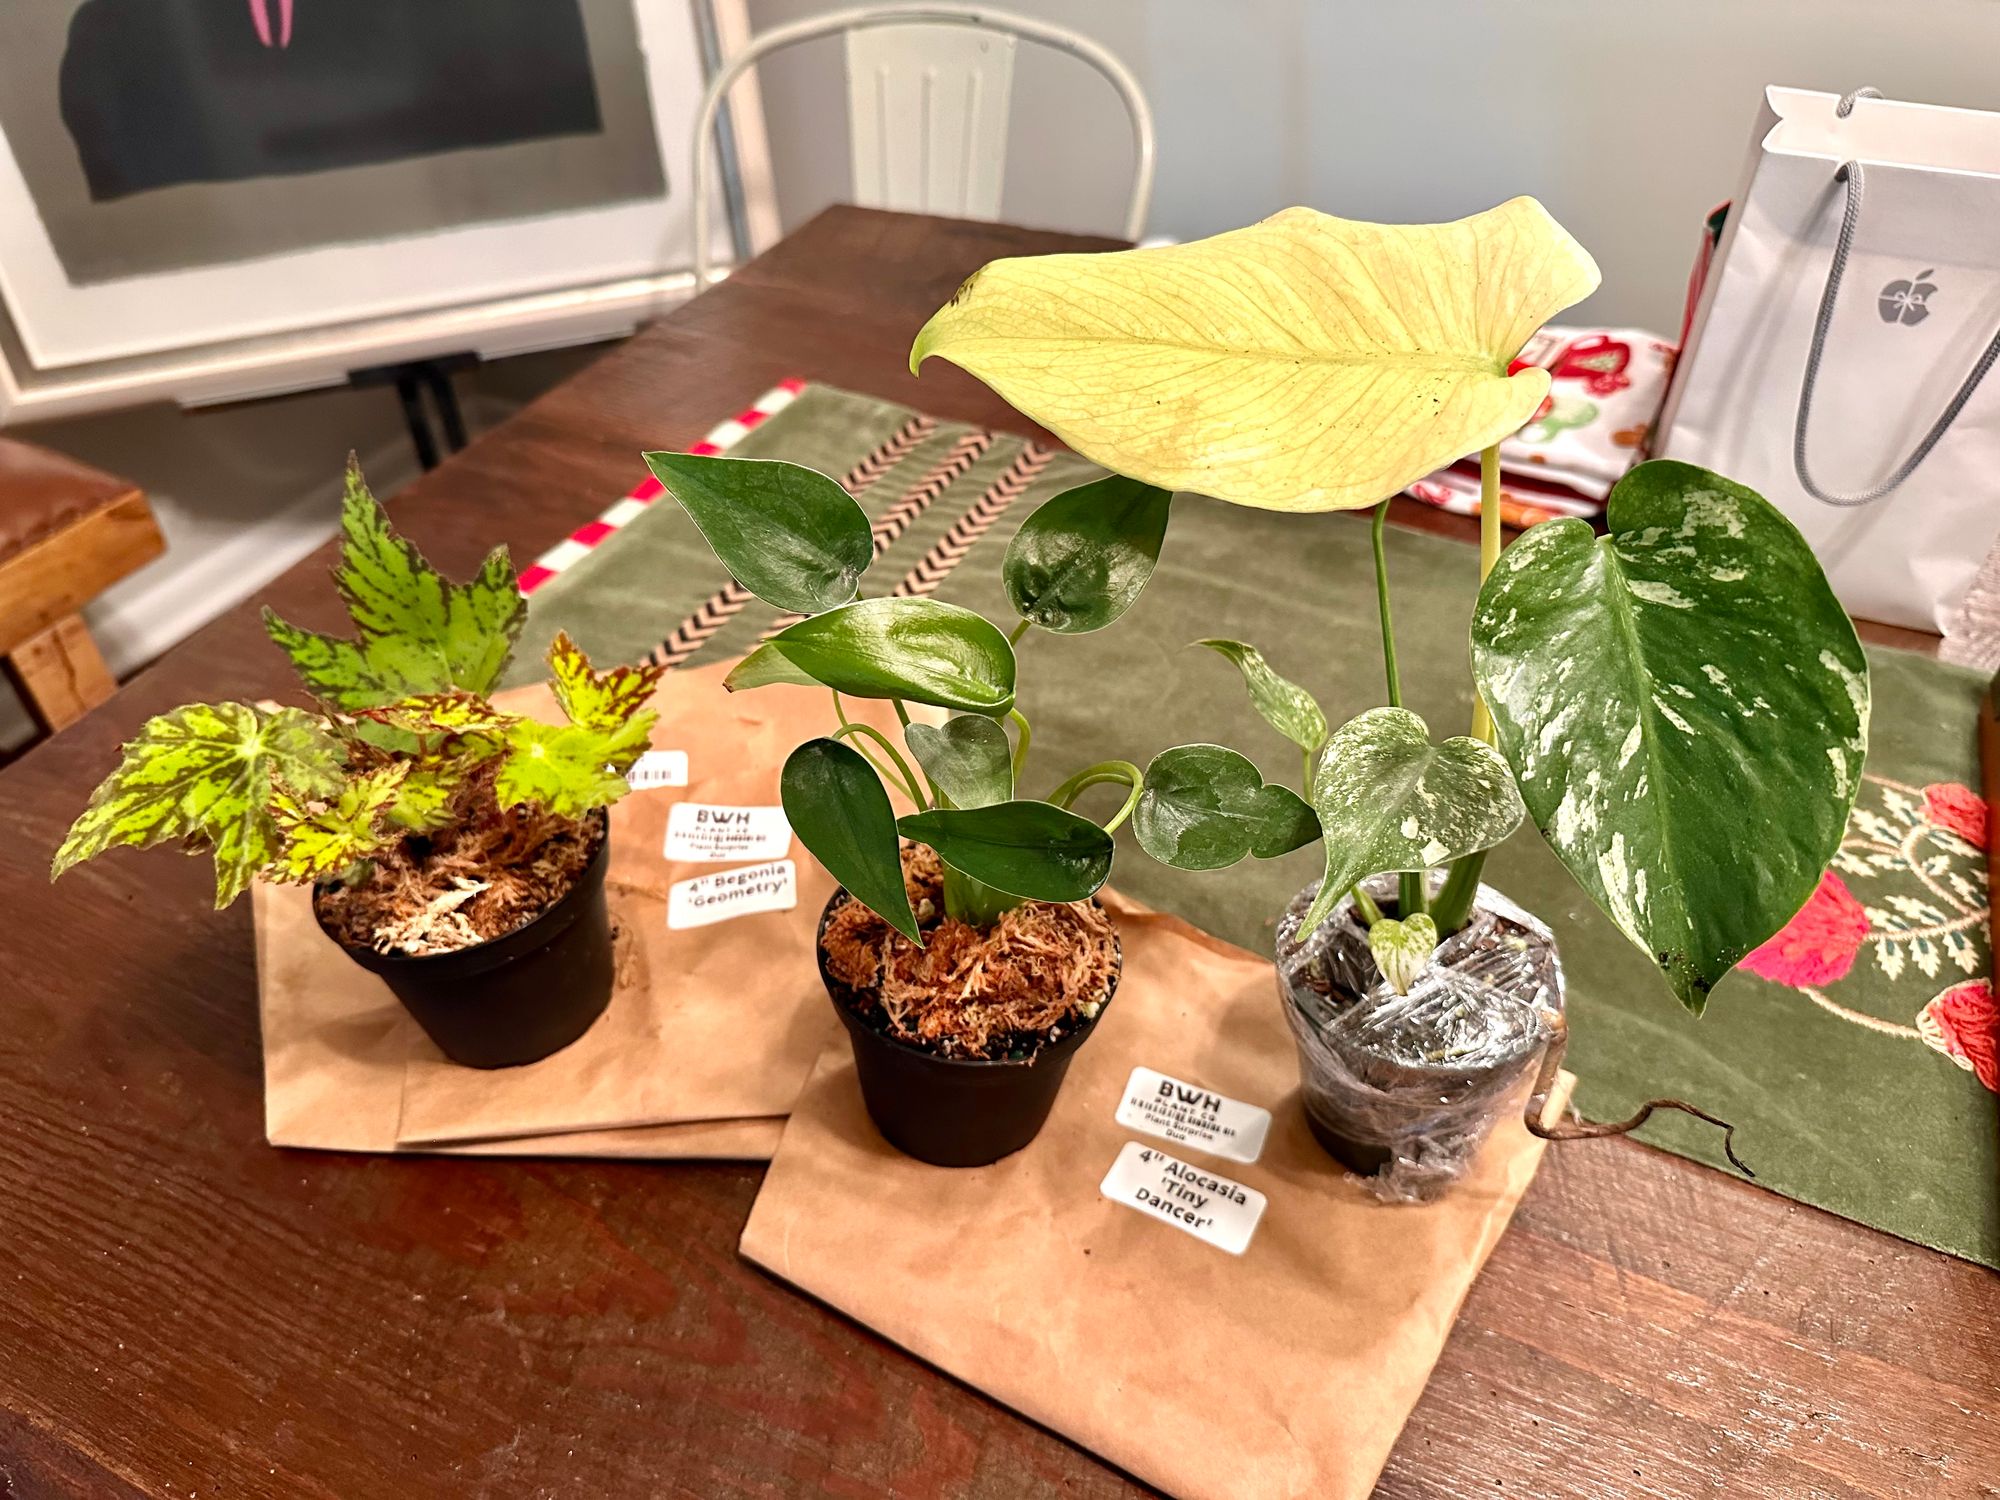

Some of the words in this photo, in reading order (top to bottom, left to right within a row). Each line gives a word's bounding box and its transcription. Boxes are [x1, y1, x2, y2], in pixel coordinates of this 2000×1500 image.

[696, 809, 750, 824] BWH
[715, 864, 786, 888] Begonia
[688, 878, 788, 907] 'Geometry'
[1154, 1097, 1196, 1115] PLANT
[1157, 1079, 1222, 1113] BWH
[1145, 1112, 1171, 1128] Plant
[1173, 1120, 1214, 1141] Surprise
[1165, 1129, 1186, 1141] Duo
[1161, 1176, 1209, 1210] 'Tiny
[1164, 1161, 1247, 1206] Alocasia
[1135, 1187, 1213, 1228] Dancer'
